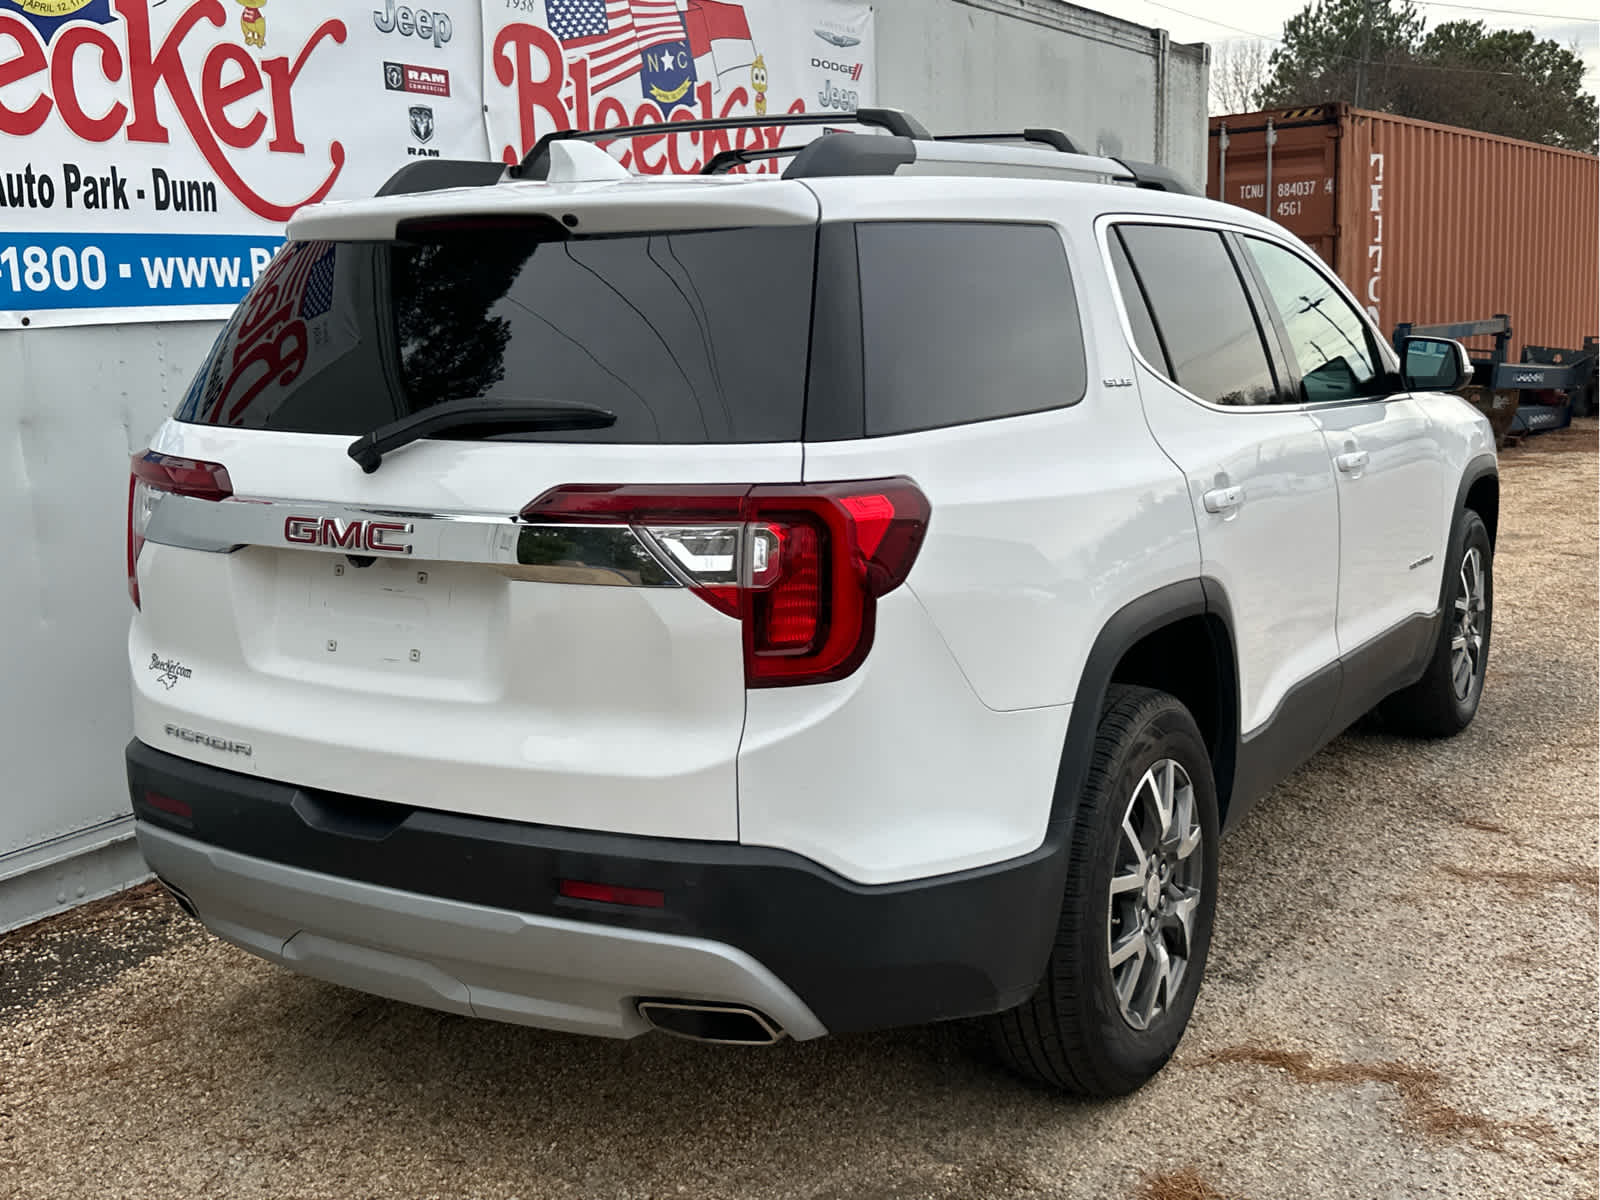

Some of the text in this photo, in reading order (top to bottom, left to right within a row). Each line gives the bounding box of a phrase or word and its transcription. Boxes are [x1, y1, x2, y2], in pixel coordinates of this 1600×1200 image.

[373, 0, 452, 48] Jeep
[647, 51, 688, 72] N C
[811, 58, 856, 75] DODGE
[407, 70, 446, 83] RAM
[818, 80, 858, 112] Jeep
[407, 147, 439, 157] RAM
[63, 163, 129, 210] Park
[152, 167, 217, 213] Dunn
[1240, 178, 1333, 199] TCNU 884037 4
[1277, 201, 1301, 216] 45G1
[0, 246, 107, 292] 1800
[285, 516, 413, 554] GMC
[164, 724, 252, 756] ACADIA
